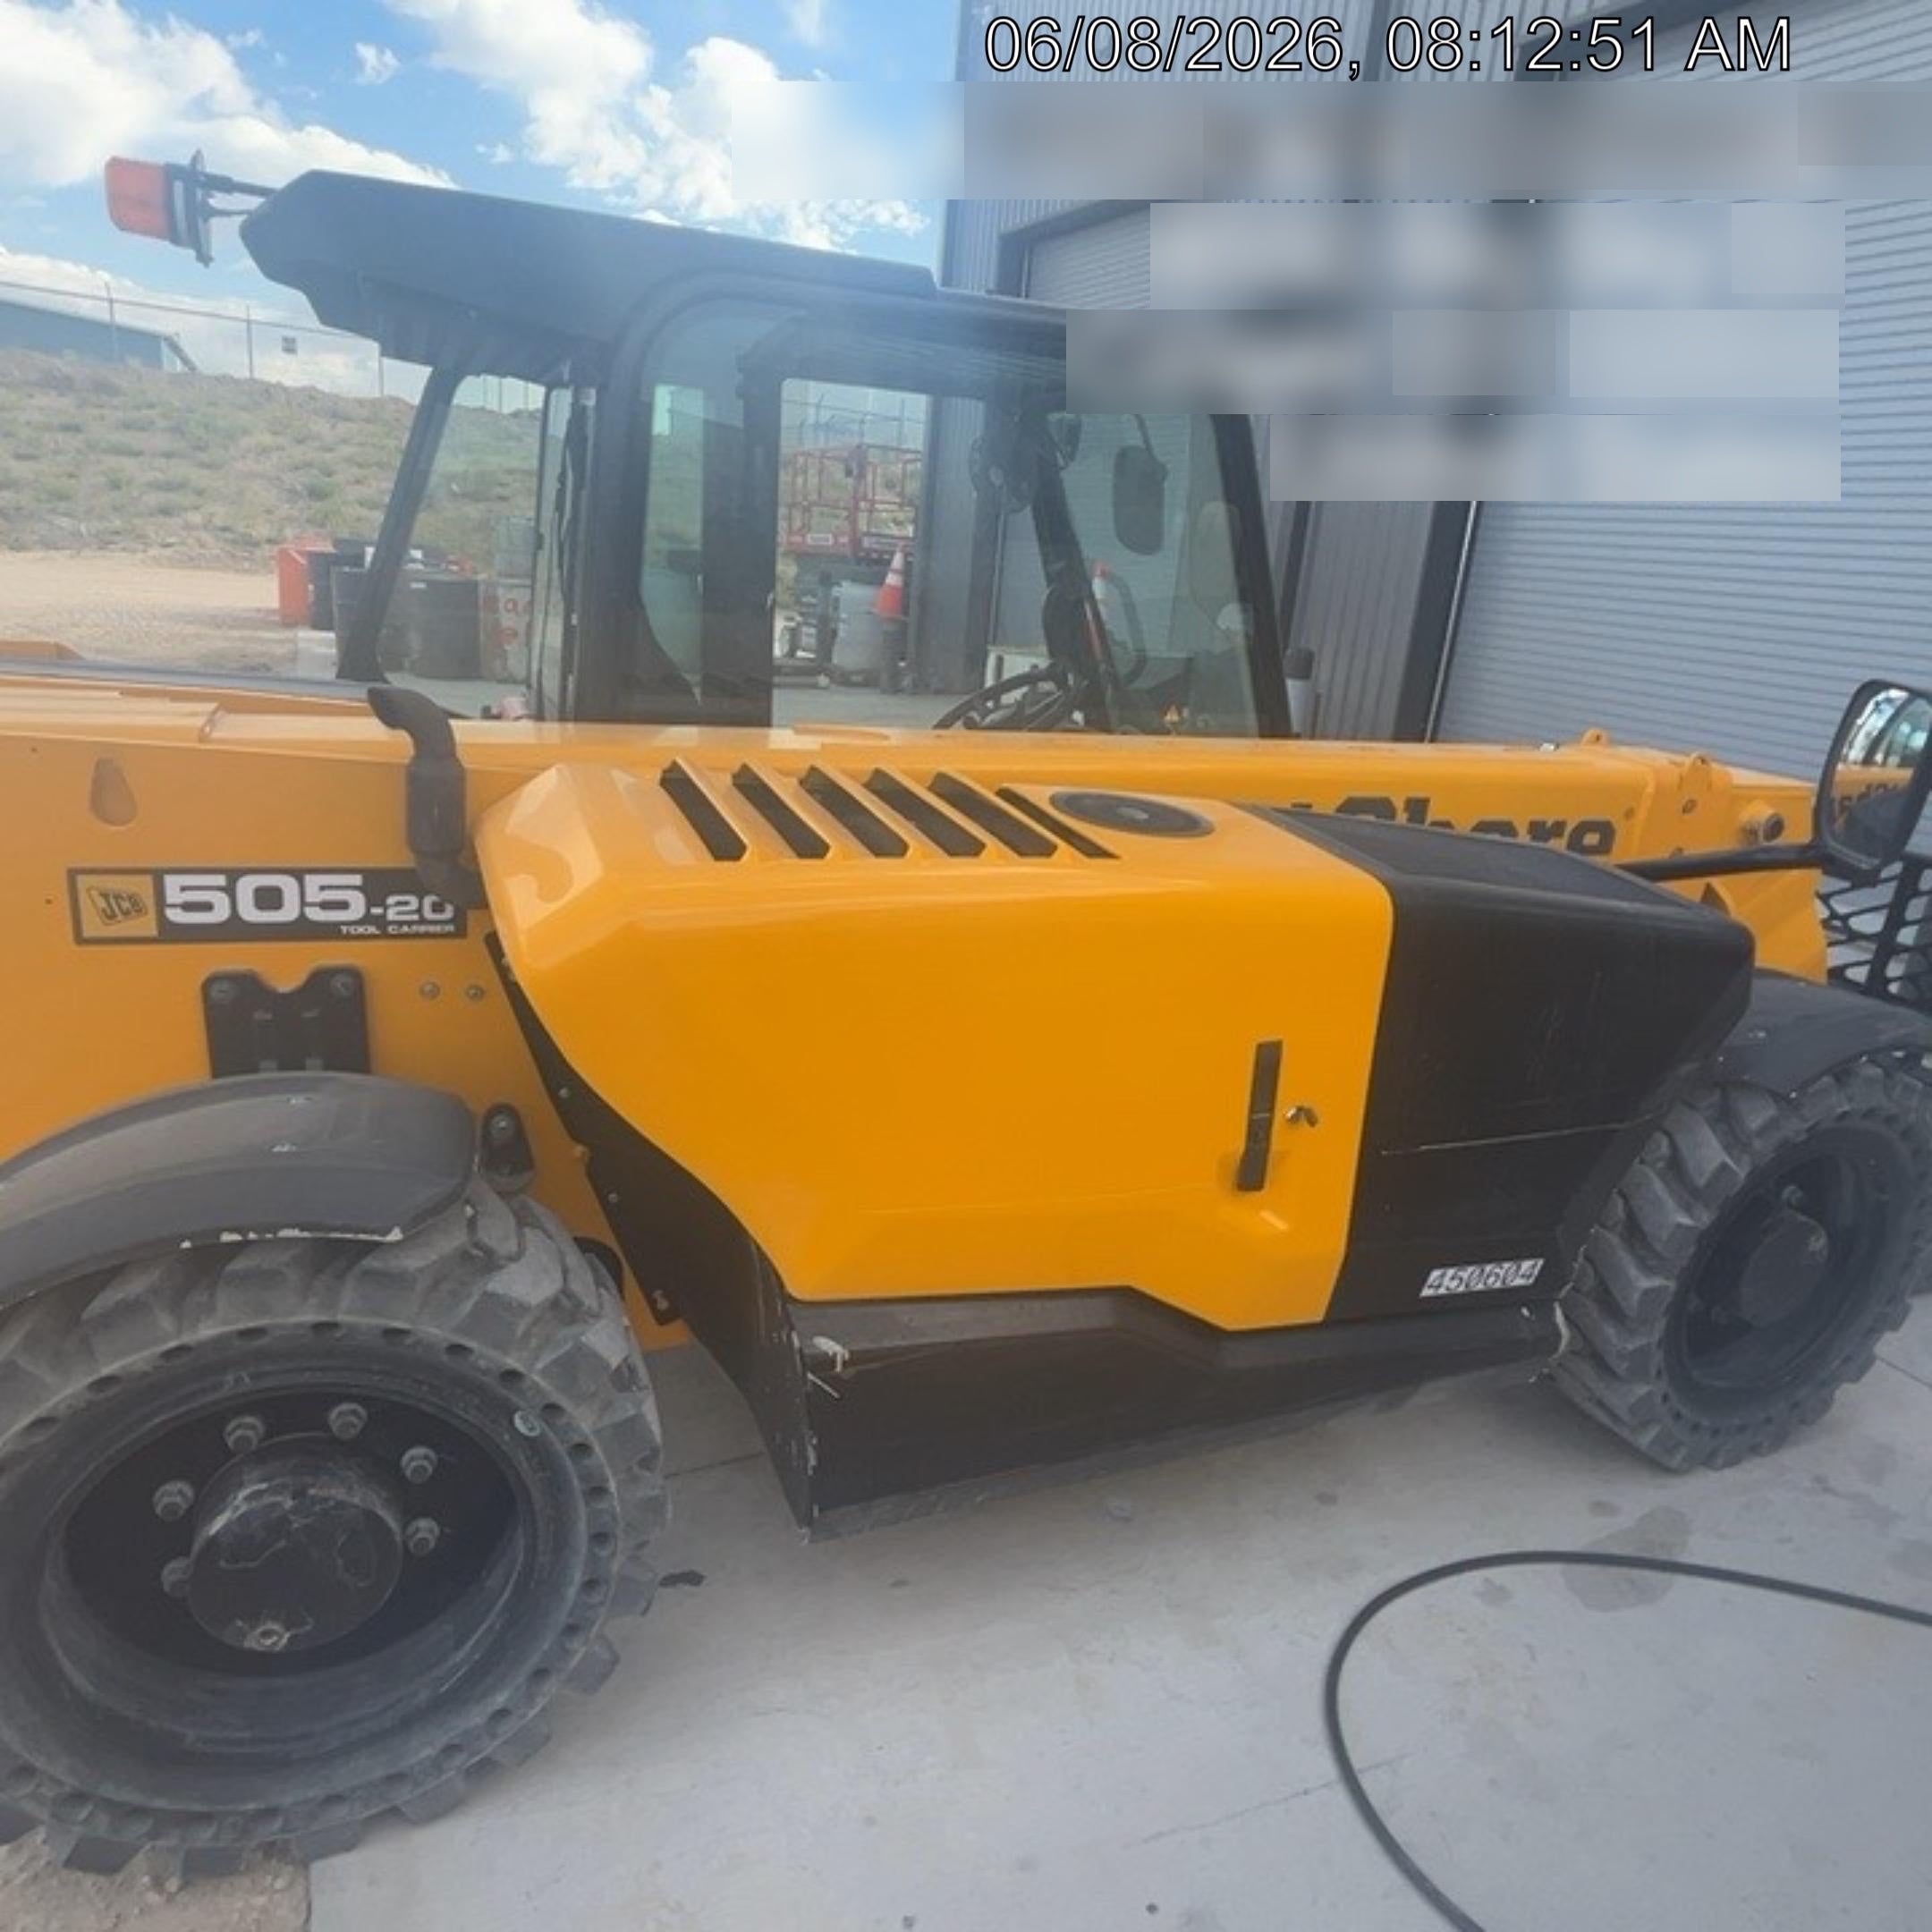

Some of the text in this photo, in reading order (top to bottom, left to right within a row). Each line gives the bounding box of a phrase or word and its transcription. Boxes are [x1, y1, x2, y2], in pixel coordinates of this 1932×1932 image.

[95, 891, 146, 923] JCB
[163, 874, 454, 924] 505-20
[340, 924, 382, 936] TOOL
[1425, 1259, 1541, 1293] 450604
